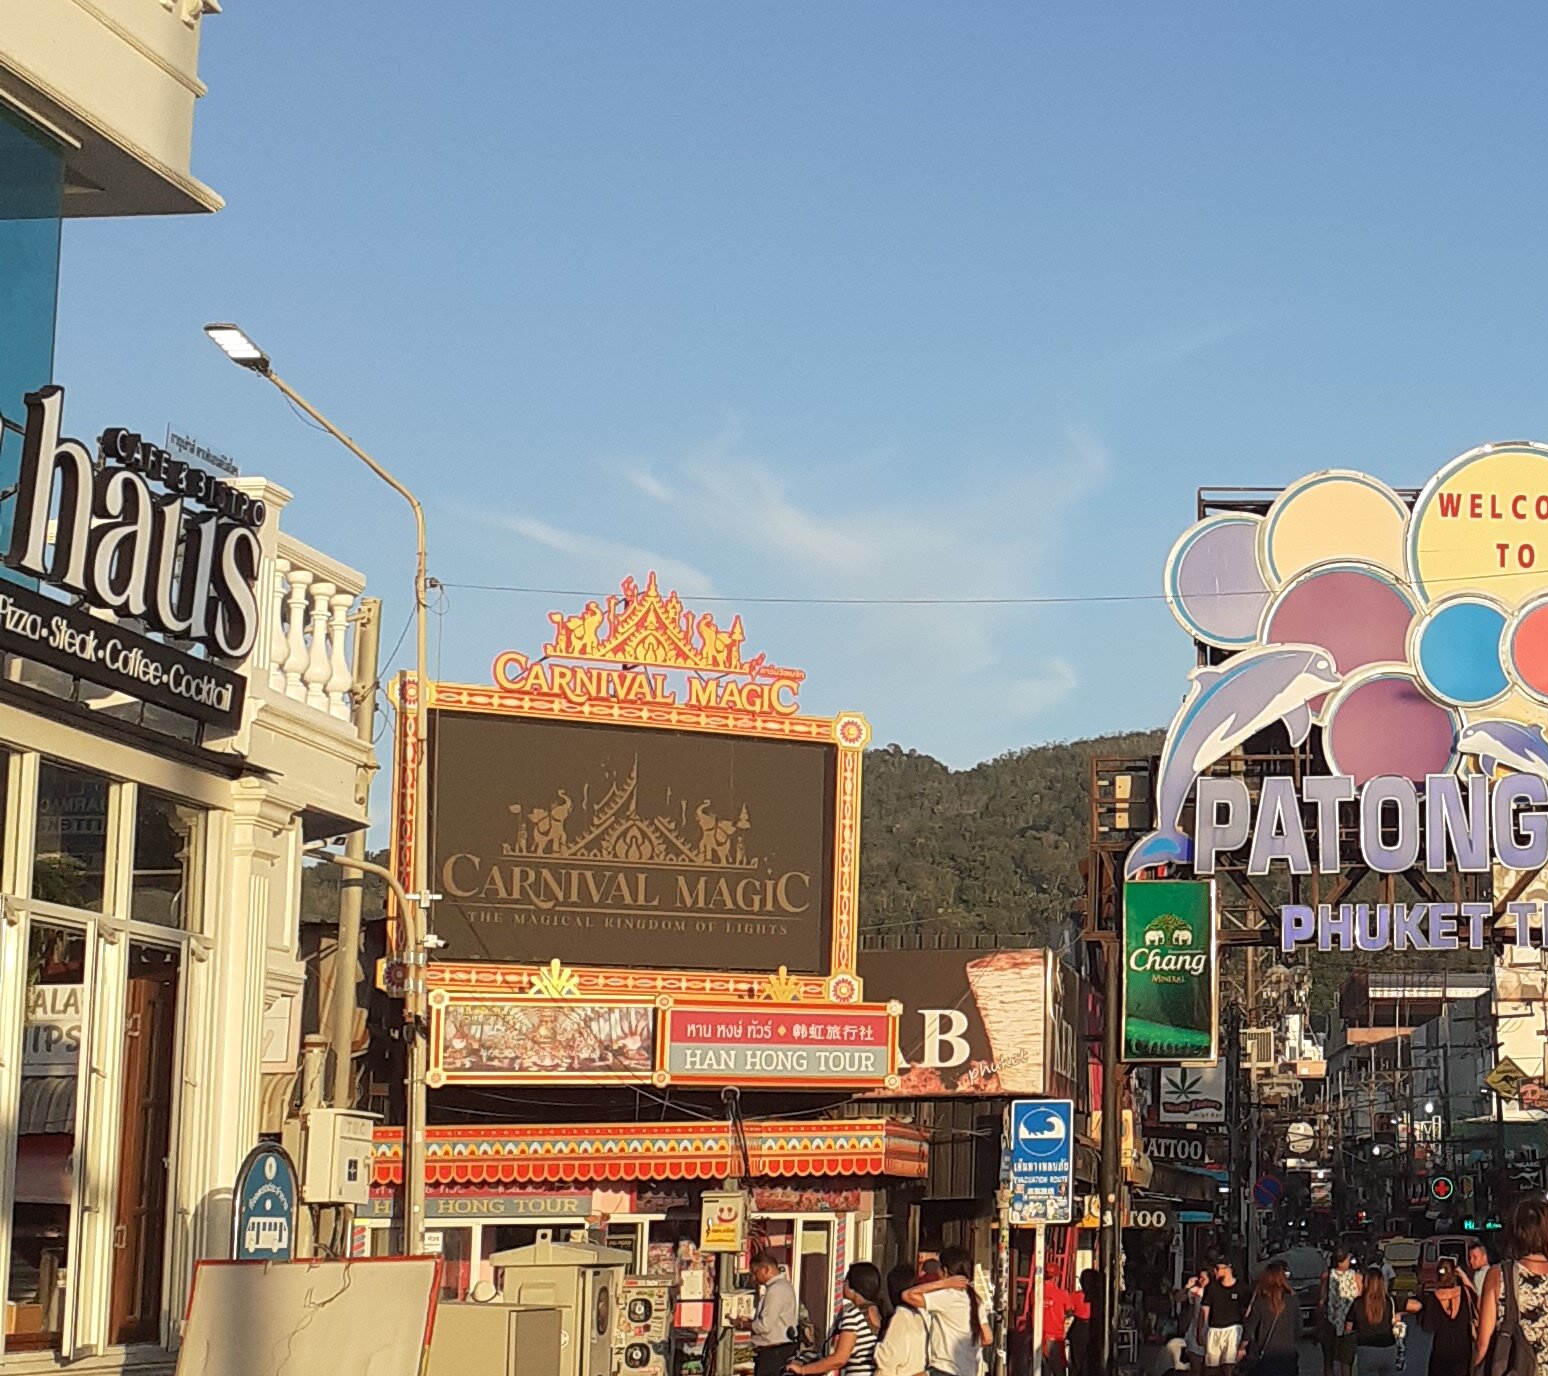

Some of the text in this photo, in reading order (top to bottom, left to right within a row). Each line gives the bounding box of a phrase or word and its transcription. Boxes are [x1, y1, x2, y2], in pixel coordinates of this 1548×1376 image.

[117, 430, 171, 479] CAFE
[20, 386, 261, 658] haus
[1496, 542, 1537, 570] TO
[49, 616, 98, 663] Steak
[105, 639, 162, 686] Coffee
[169, 664, 233, 713] Cocktail
[494, 652, 799, 714] CARNIVAL MAGIC
[442, 852, 811, 913] CARNIVAL MAGIC
[467, 911, 788, 936] THE MAGICAL KINGDOM OF LIGHTS
[1280, 901, 1495, 952] PHUKET
[1129, 947, 1208, 976] Chang
[684, 1049, 875, 1072] HAN HONG TOUR
[968, 1047, 1030, 1086] phuket
[437, 1198, 580, 1214] HONG TOUR
